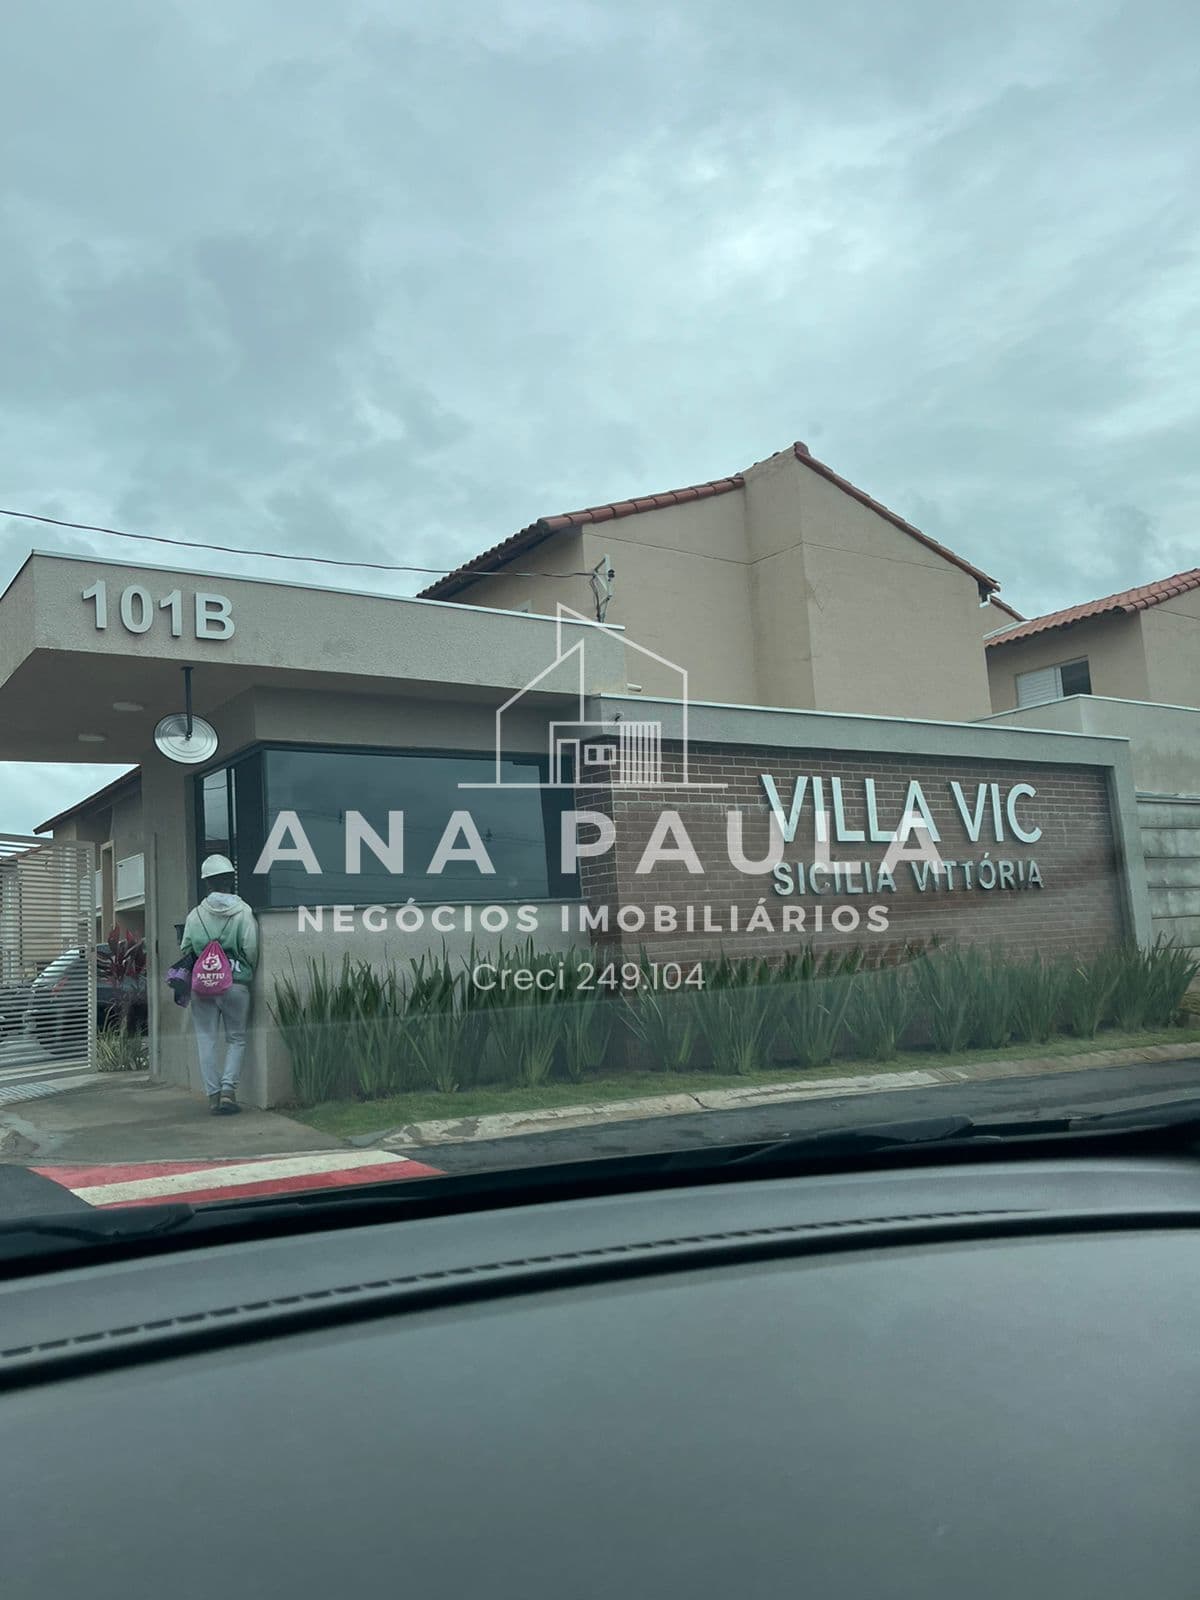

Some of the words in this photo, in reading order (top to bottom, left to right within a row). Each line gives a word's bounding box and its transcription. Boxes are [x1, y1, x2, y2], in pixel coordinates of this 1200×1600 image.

[82, 580, 236, 641] 101B
[760, 773, 942, 844] VILLA
[950, 780, 1043, 844] VIC
[772, 860, 897, 896] SICILIA
[910, 851, 1045, 891] VITTÓRIA
